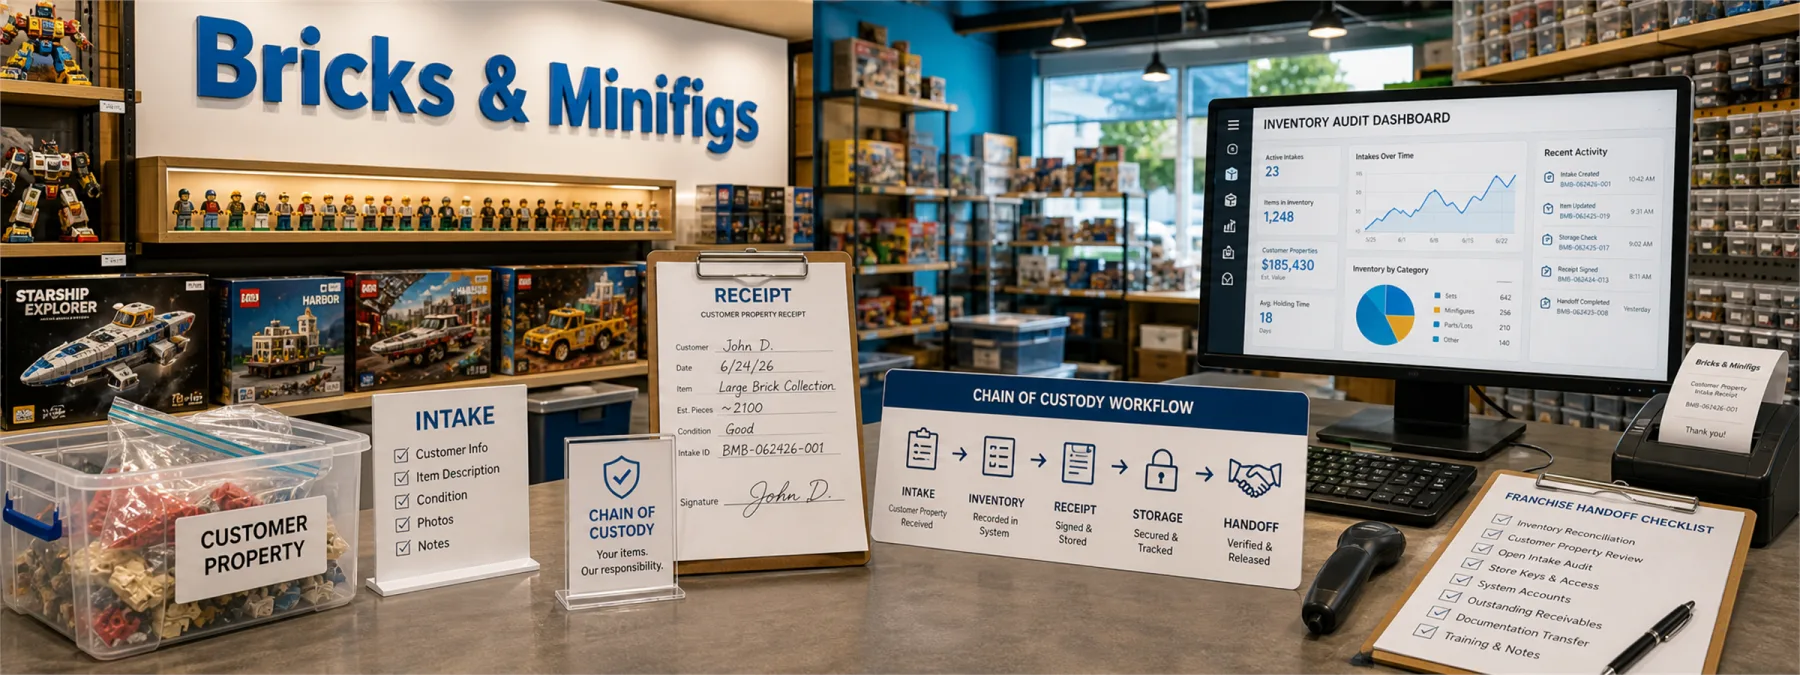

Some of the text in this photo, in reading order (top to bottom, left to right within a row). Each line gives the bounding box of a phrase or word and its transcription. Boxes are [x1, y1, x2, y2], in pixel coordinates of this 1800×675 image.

[195, 15, 760, 155] Bricks & Minifigs
[1264, 112, 1450, 129] INVENTORY AUDIT DASHBOARD
[1398, 152, 1414, 160] Time
[1544, 147, 1608, 157] Recent Activity
[1265, 166, 1279, 177] 23
[1264, 211, 1294, 224] 1,248
[1289, 247, 1318, 255] Properties
[1262, 258, 1314, 272] $185,430
[1353, 265, 1429, 275] Inventory by Category
[1557, 265, 1599, 274] Receipt Signed
[16, 288, 90, 303] STARSHIP
[303, 295, 339, 305] HARBOR
[715, 288, 792, 303] RECEIPT
[1445, 292, 1457, 300] Sets
[1580, 298, 1610, 306] Completed
[25, 300, 97, 316] EXPLORER
[1259, 300, 1310, 308] Avg. Holding Time
[1623, 305, 1651, 313] Yesterday
[778, 310, 806, 318] RECEIPT
[1260, 312, 1272, 323] 18
[1444, 307, 1475, 315] Minifigures
[1444, 322, 1473, 330] Parts/Lots
[675, 343, 709, 351] Customer
[723, 339, 774, 352] John D.
[676, 363, 693, 372] Date
[720, 359, 774, 375] 6/24/26
[1695, 358, 1720, 367] Bricks
[1729, 362, 1761, 372] Minifigs
[676, 385, 693, 393] Item
[719, 380, 836, 398] Large Brick Collection
[1690, 380, 1747, 393] Customer Property
[973, 388, 1194, 414] CHAIN OF CUSTODY WORKFLOW
[1714, 391, 1738, 399] Receipt
[677, 406, 714, 414] Est. Pieces
[722, 402, 763, 413] ~2100
[416, 406, 495, 431] INTAKE
[677, 427, 711, 435] Condition
[726, 422, 754, 436] Good
[1685, 426, 1726, 438] Thank you!
[416, 442, 488, 459] Customer Info
[678, 448, 711, 457] Intake ID
[723, 442, 825, 457] BMB-062426-001
[417, 465, 500, 482] Item Description
[417, 491, 467, 505] Condition
[742, 479, 832, 518] John D.
[902, 486, 935, 499] INTAKE
[680, 498, 718, 508] Signature
[969, 494, 1025, 507] INVENTORY
[589, 506, 655, 522] CHAIN OF
[888, 504, 947, 519] Customer Property
[1054, 501, 1097, 515] RECEIPT
[1505, 491, 1714, 534] FRANCHISE HANDOFF CHECKLIST
[418, 515, 454, 528] Photos
[973, 512, 1019, 526] Recorded in
[1133, 509, 1183, 523] STORAGE
[901, 518, 933, 529] Received
[1056, 521, 1093, 534] Signed &
[1224, 518, 1279, 532] HANDOFF
[200, 514, 307, 550] CUSTOMER
[590, 523, 654, 539] CUSTODY
[980, 526, 1009, 537] System
[1134, 529, 1179, 543] Secured &
[1517, 520, 1635, 547] Inventory Reconciliation
[418, 539, 450, 552] Notes
[1059, 534, 1087, 546] Stored
[1227, 538, 1273, 552] Verified &
[597, 548, 648, 559] Your items.
[1138, 543, 1173, 555] Tracked
[1508, 534, 1643, 563] Customer Property Review
[203, 539, 305, 576] PROPERTY
[1229, 552, 1270, 565] Released
[1498, 549, 1593, 571] Open Intake Audit
[581, 561, 663, 576] Our responsibility.
[1489, 564, 1599, 590] Store Keys & Access
[1478, 580, 1571, 603] System Accounts
[1468, 597, 1602, 629] Outstanding Receivables
[1455, 613, 1590, 647] Documentation Transfer
[1445, 631, 1540, 659] Training & Notes
